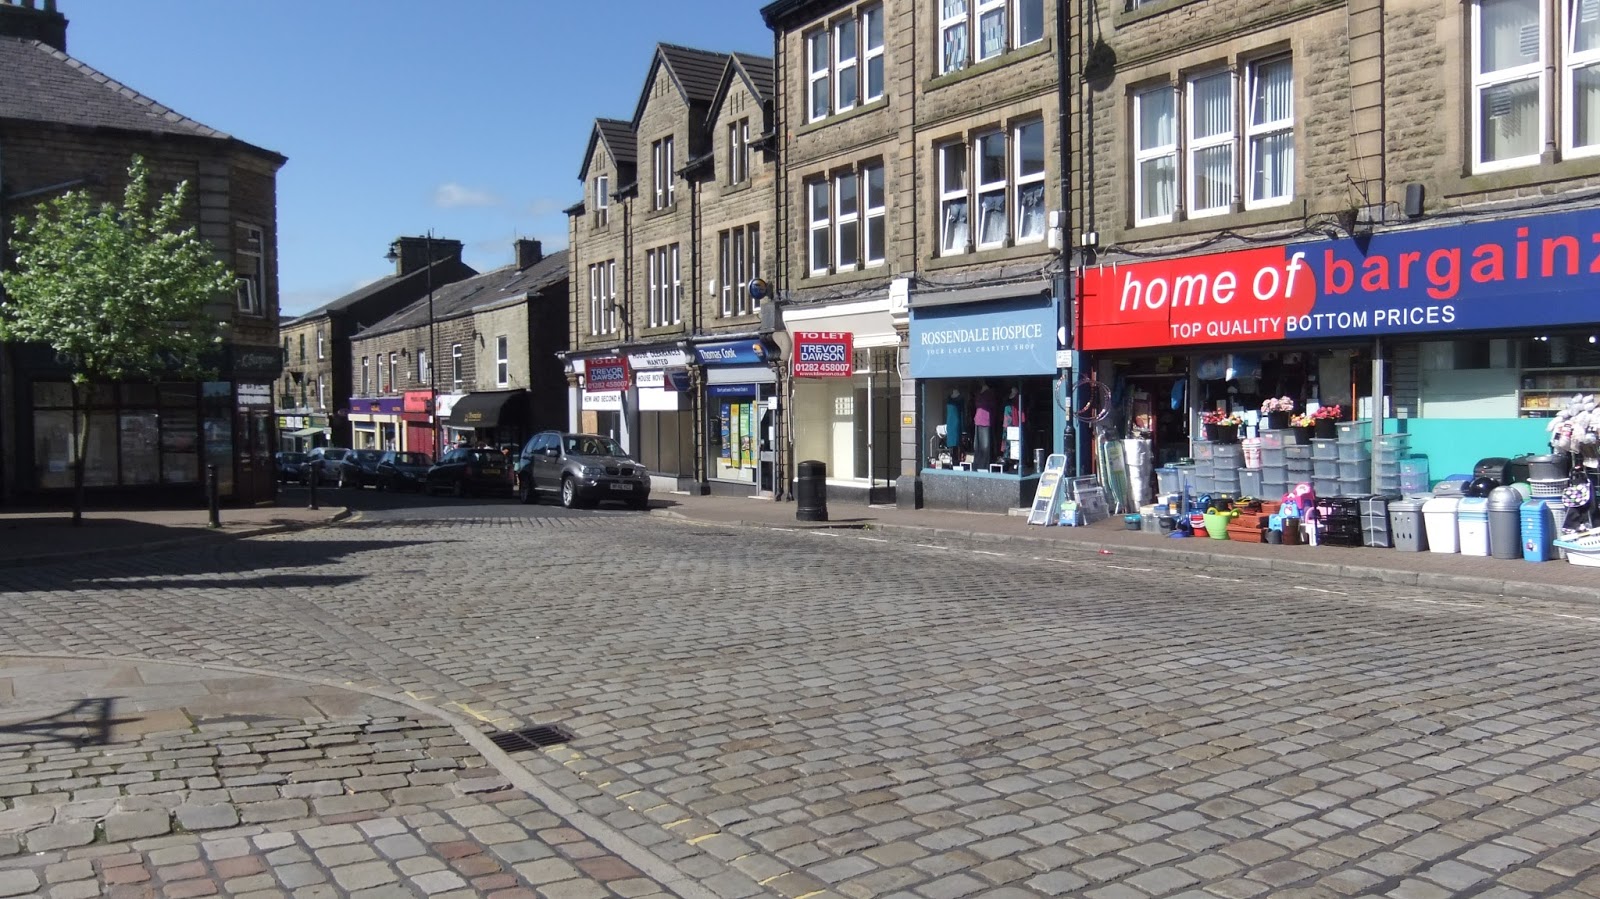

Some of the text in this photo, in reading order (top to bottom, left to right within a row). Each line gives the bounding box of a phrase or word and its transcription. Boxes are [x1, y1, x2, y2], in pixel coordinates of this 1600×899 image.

[1119, 270, 1238, 311] home
[1252, 251, 1306, 301] of
[1170, 305, 1456, 339] TOP QUALITY BOTTOM PRICES
[921, 323, 1043, 345] ROSSENDALE HOSPICE
[699, 347, 737, 359] Thomas Cook
[801, 344, 844, 354] TREVOR
[975, 345, 1010, 353] CHARITY
[801, 352, 845, 361] DAWSON
[646, 358, 669, 366] WANTED
[591, 367, 623, 376] TREVOR
[795, 363, 850, 372] 01282 458007
